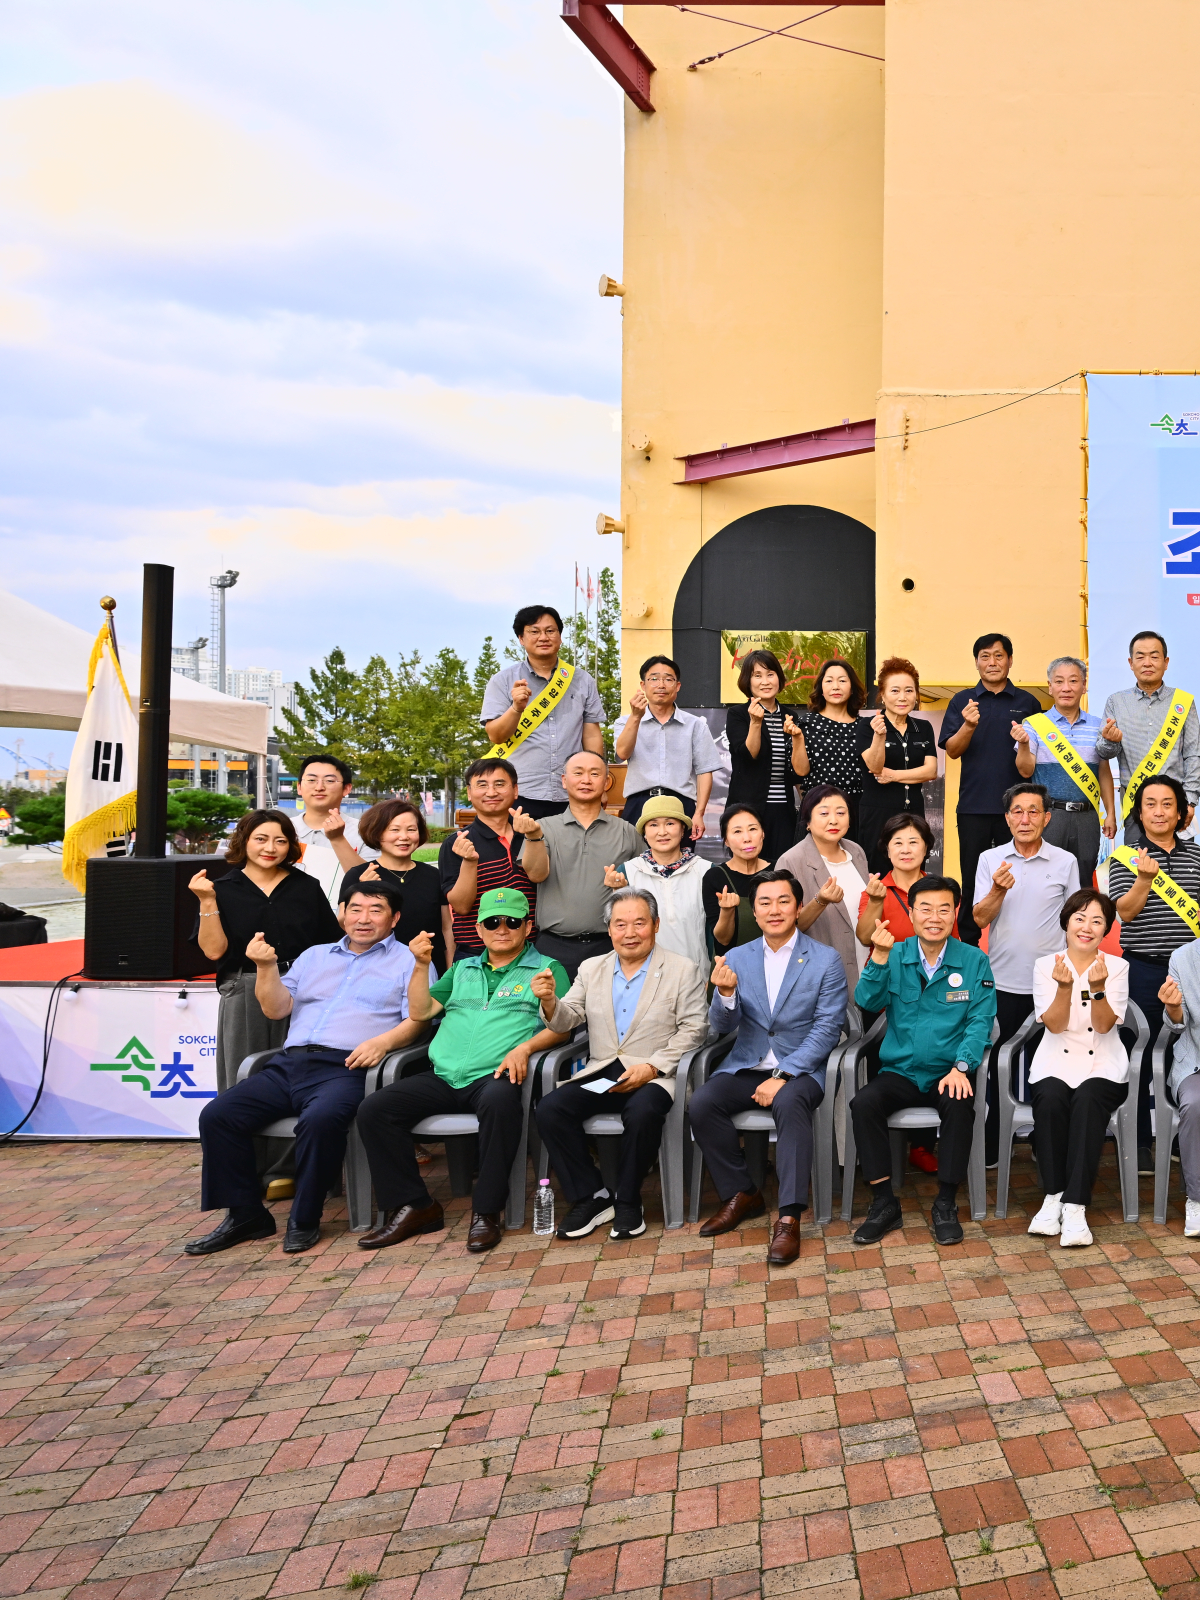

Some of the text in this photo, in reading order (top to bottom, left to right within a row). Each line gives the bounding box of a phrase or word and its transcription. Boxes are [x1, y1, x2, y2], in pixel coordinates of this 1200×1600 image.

[1149, 413, 1199, 436] 속초
[178, 1035, 216, 1045] SOKCH
[198, 1047, 217, 1057] CIT
[89, 1035, 218, 1099] 속초
